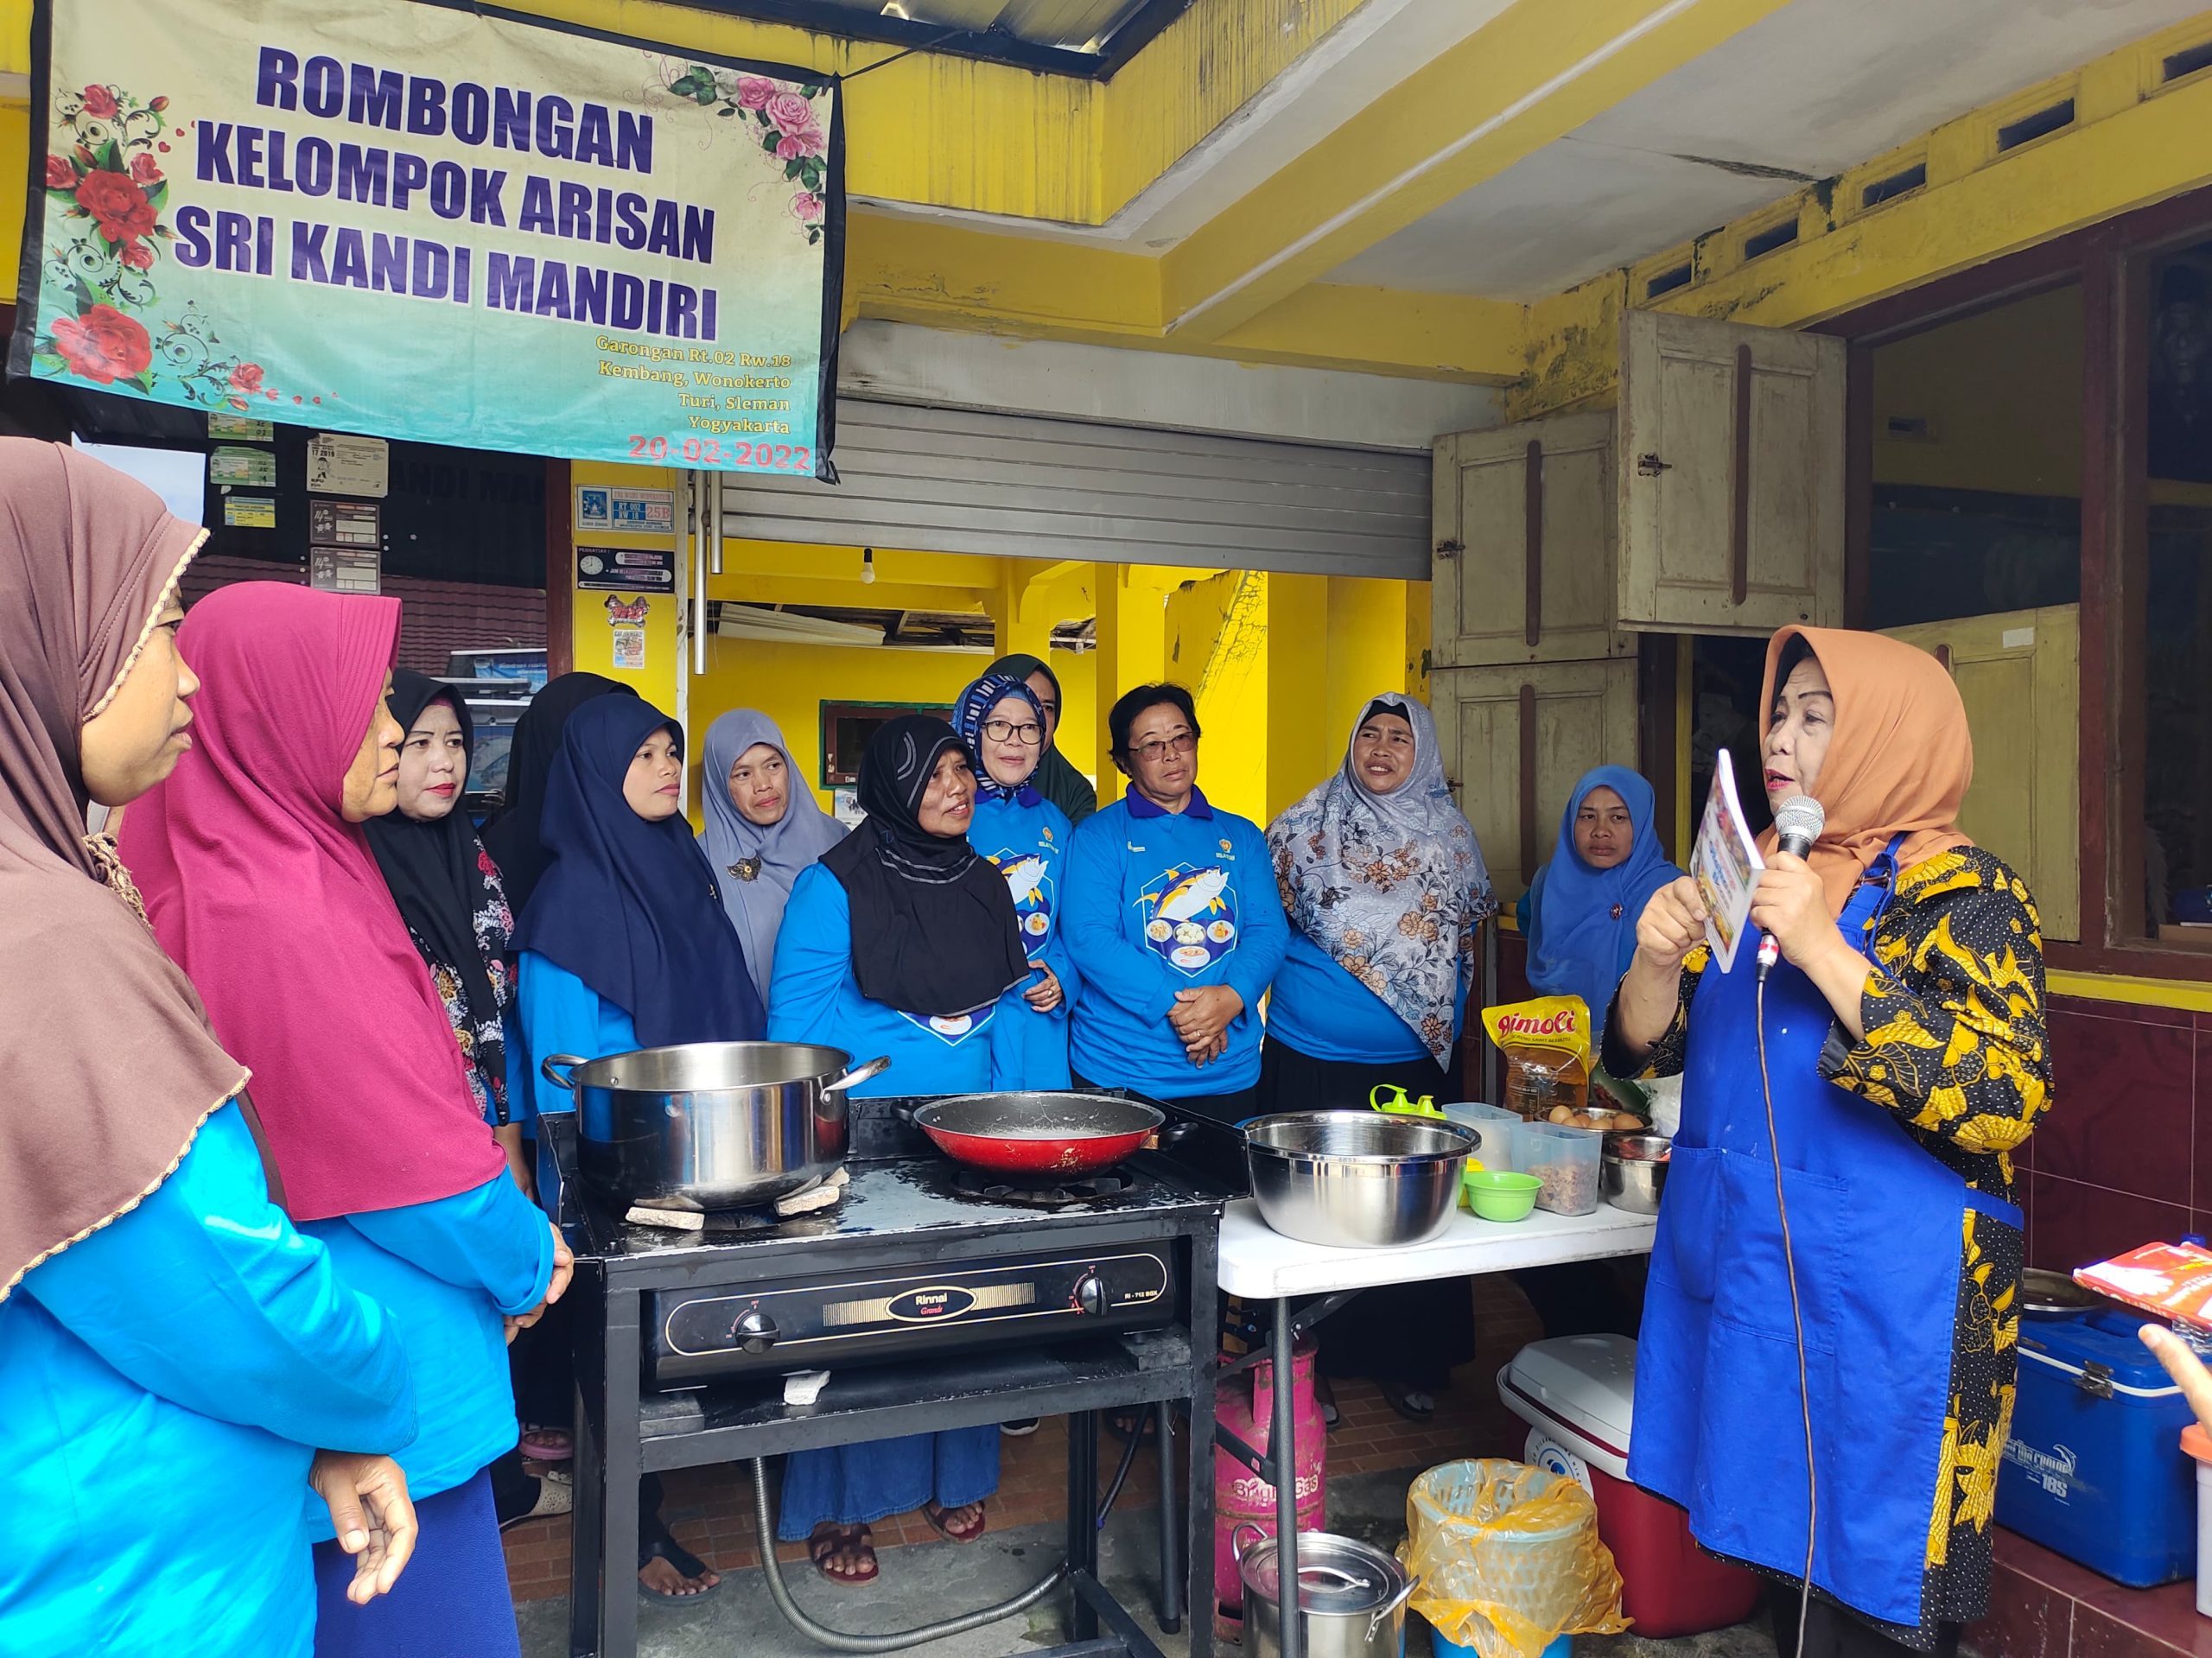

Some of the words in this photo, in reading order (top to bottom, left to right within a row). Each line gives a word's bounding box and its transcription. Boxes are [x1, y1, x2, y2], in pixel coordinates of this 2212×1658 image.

[257, 47, 653, 174] ROMBONGAN
[197, 120, 506, 226] KELOMPOK
[519, 175, 715, 263] ARISAN
[175, 206, 275, 275] SRI
[291, 221, 471, 303] KANDI
[487, 252, 716, 340] MANDIRI
[595, 335, 684, 361] Garongan
[688, 347, 735, 366] Rt.02
[739, 353, 792, 368] Rw.18
[599, 360, 690, 388] Kembang,
[693, 372, 791, 389] Wonokerto
[678, 393, 721, 412] Turi,
[725, 394, 791, 412] Sleman
[689, 416, 790, 435] Yogyakarta
[628, 435, 811, 471] 20-02-2022
[916, 1293, 948, 1305] Rinnai
